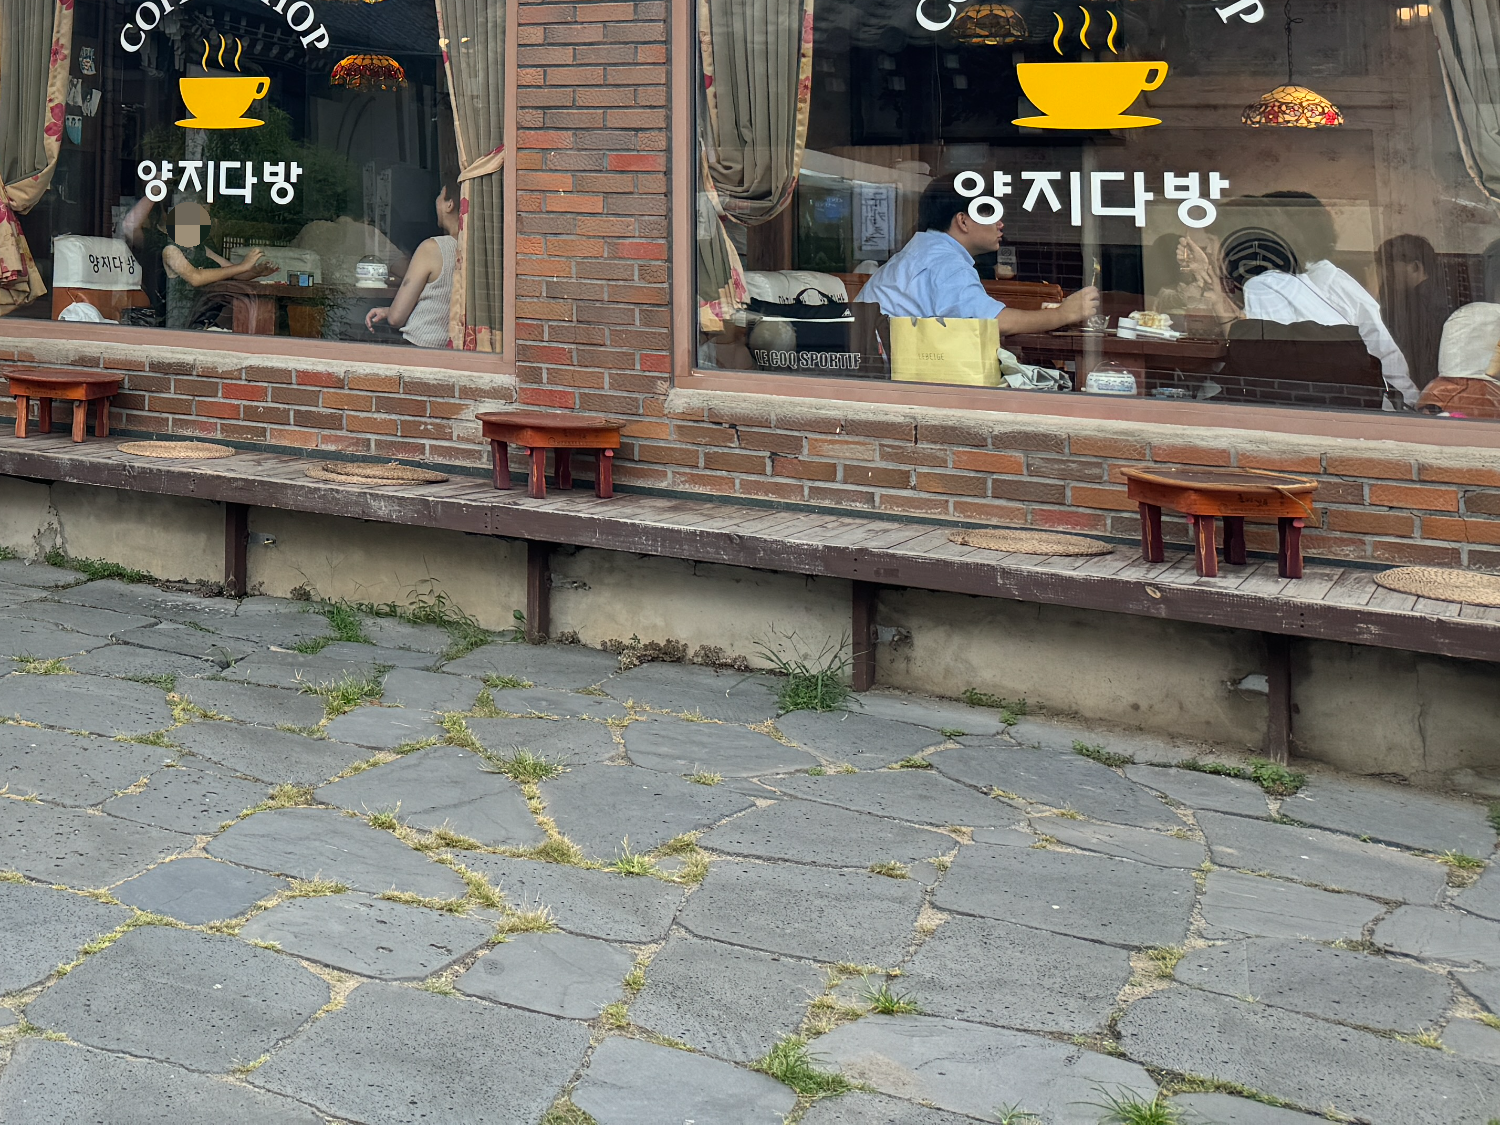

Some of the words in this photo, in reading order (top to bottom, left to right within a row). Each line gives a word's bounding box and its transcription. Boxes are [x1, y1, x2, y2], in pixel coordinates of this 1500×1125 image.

[137, 159, 303, 205] 양지다방
[953, 170, 1230, 228] 양지다방
[754, 349, 769, 367] LE
[769, 350, 798, 369] COQ
[799, 351, 862, 370] SPORTIF
